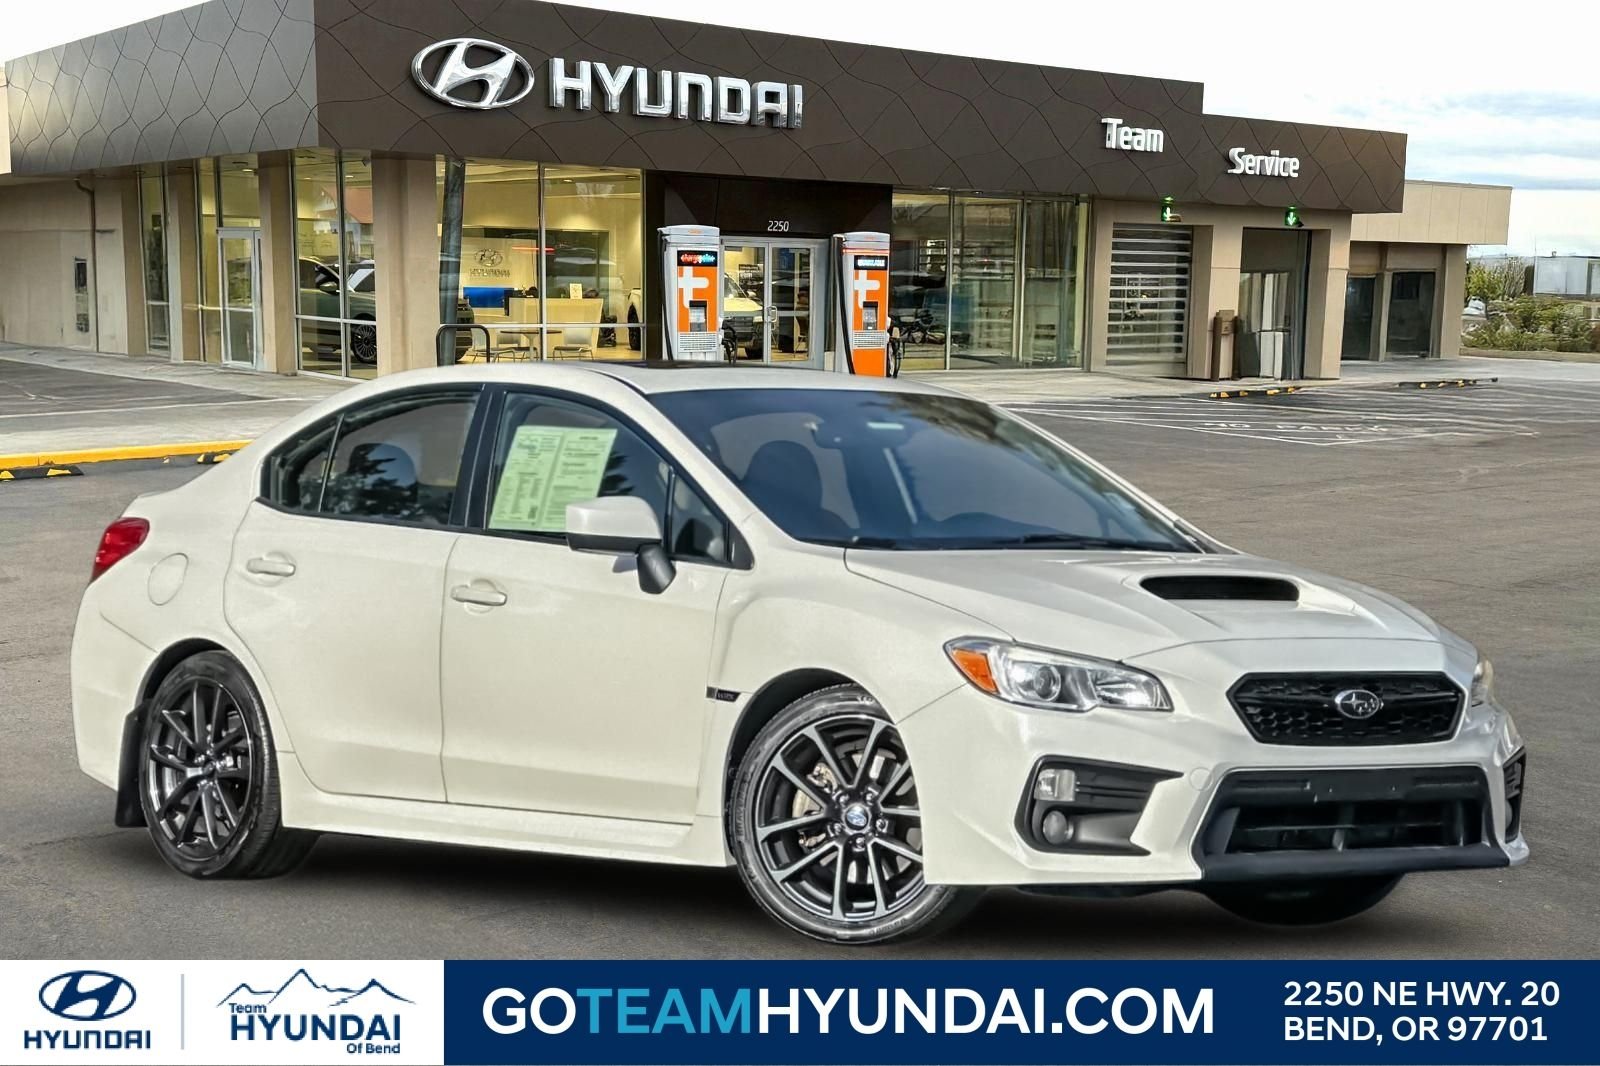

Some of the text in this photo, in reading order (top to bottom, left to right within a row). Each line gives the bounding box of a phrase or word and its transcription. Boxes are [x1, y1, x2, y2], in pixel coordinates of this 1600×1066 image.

[548, 57, 803, 129] HYUNDAI
[1101, 117, 1164, 153] Team
[1227, 147, 1300, 177] Service
[767, 220, 790, 232] 2250
